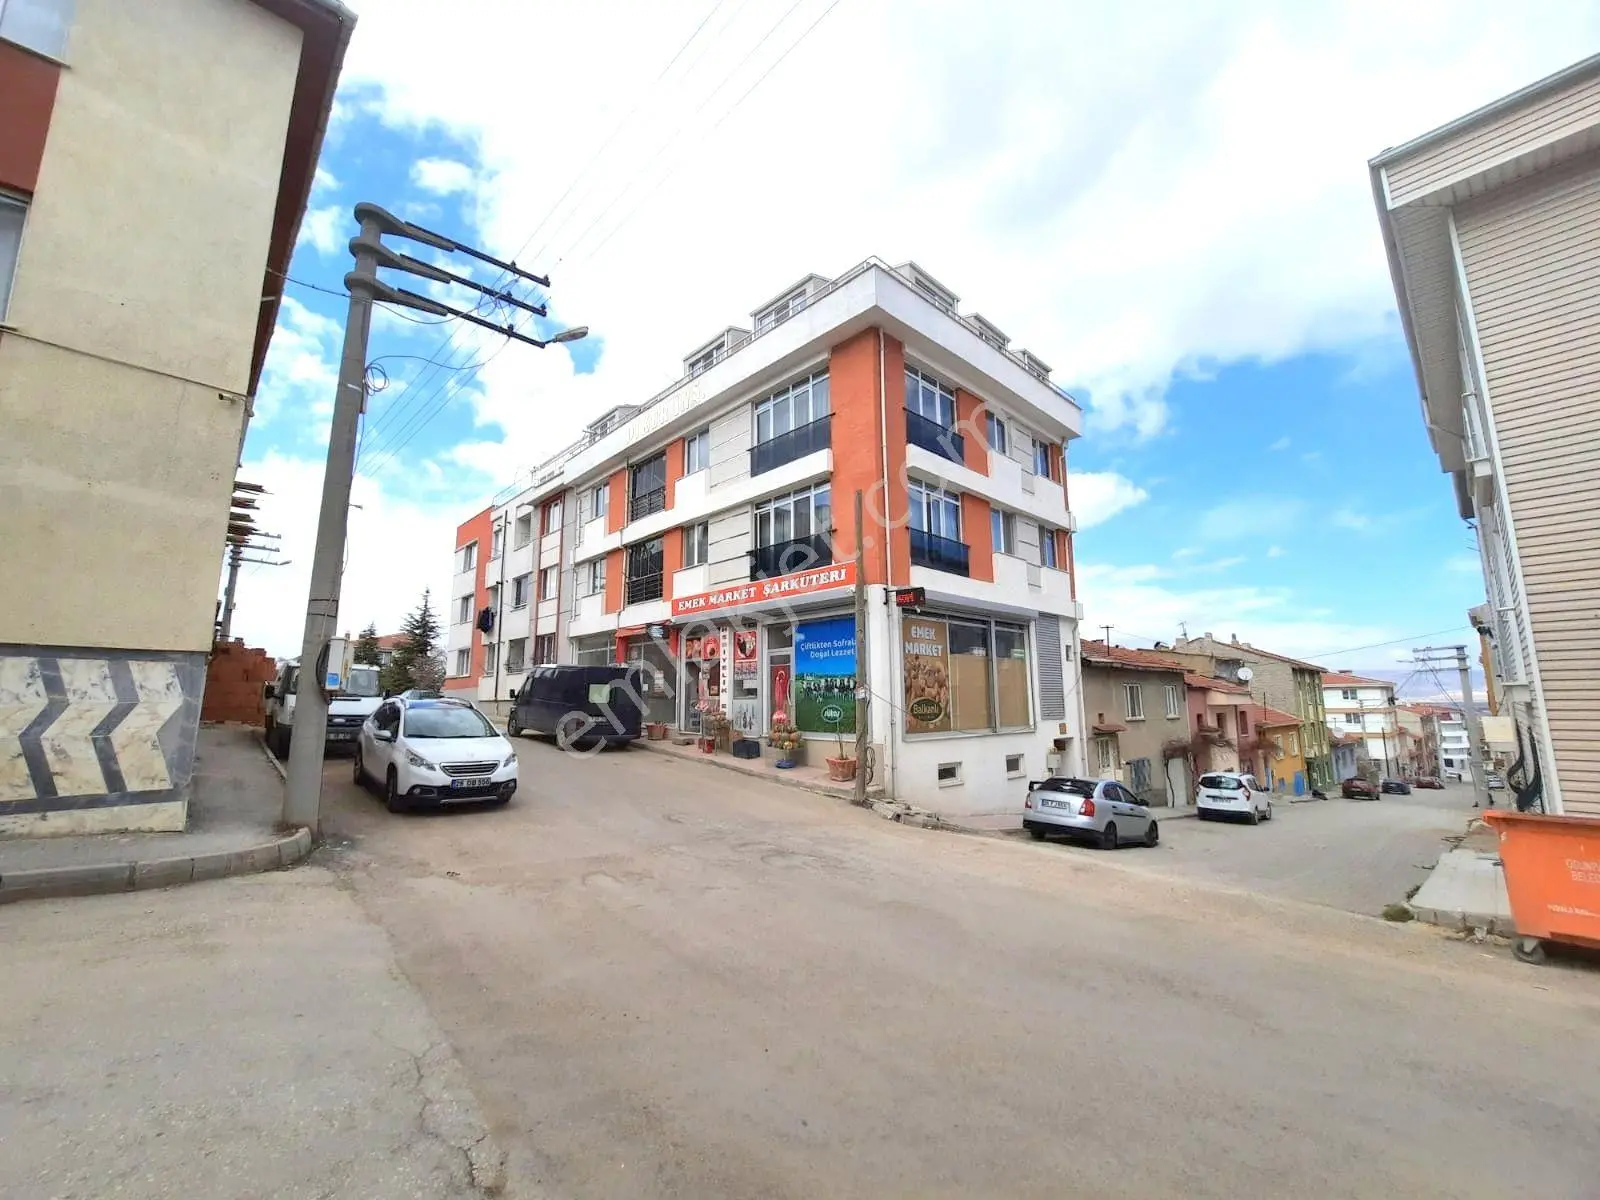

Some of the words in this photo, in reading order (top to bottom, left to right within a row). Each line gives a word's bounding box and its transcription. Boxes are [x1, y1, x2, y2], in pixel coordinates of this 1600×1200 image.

[677, 596, 707, 612] EMEK
[708, 586, 757, 605] MARKET
[910, 626, 937, 640] EMEK
[904, 642, 944, 657] MARKET
